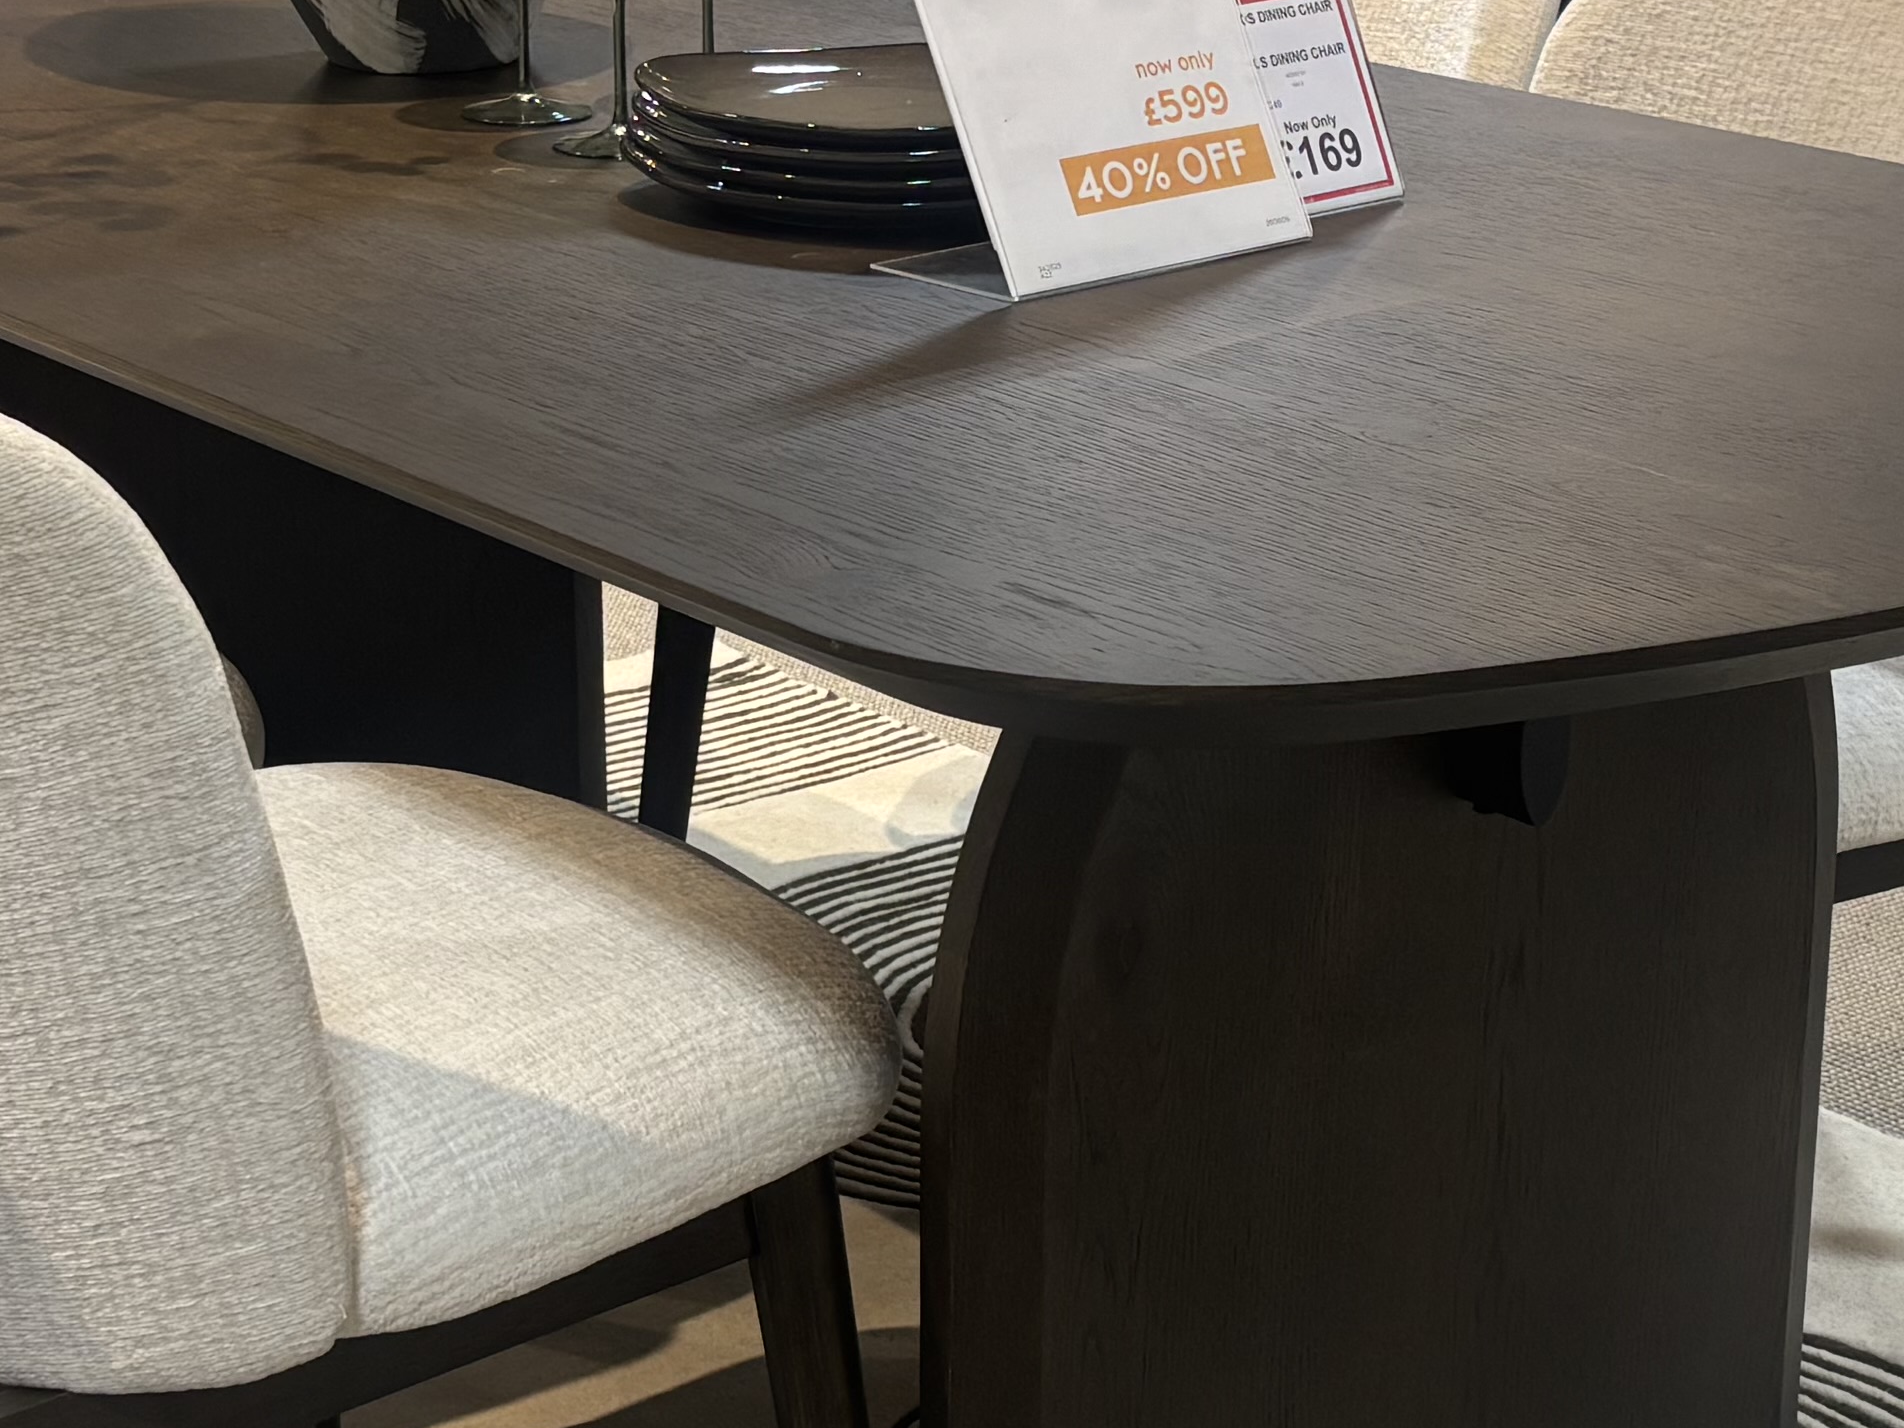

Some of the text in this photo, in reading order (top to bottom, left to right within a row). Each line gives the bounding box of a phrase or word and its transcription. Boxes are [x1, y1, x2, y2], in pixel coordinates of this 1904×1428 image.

[1257, 5, 1296, 23] DINING
[1298, 0, 1333, 16] CHAIR
[1135, 50, 1214, 79] now only
[1270, 49, 1309, 67] DINING
[1310, 42, 1346, 60] CHAIR
[1144, 81, 1229, 126] £599
[1283, 113, 1337, 135] Now Only
[1078, 138, 1247, 202] 40% OFF
